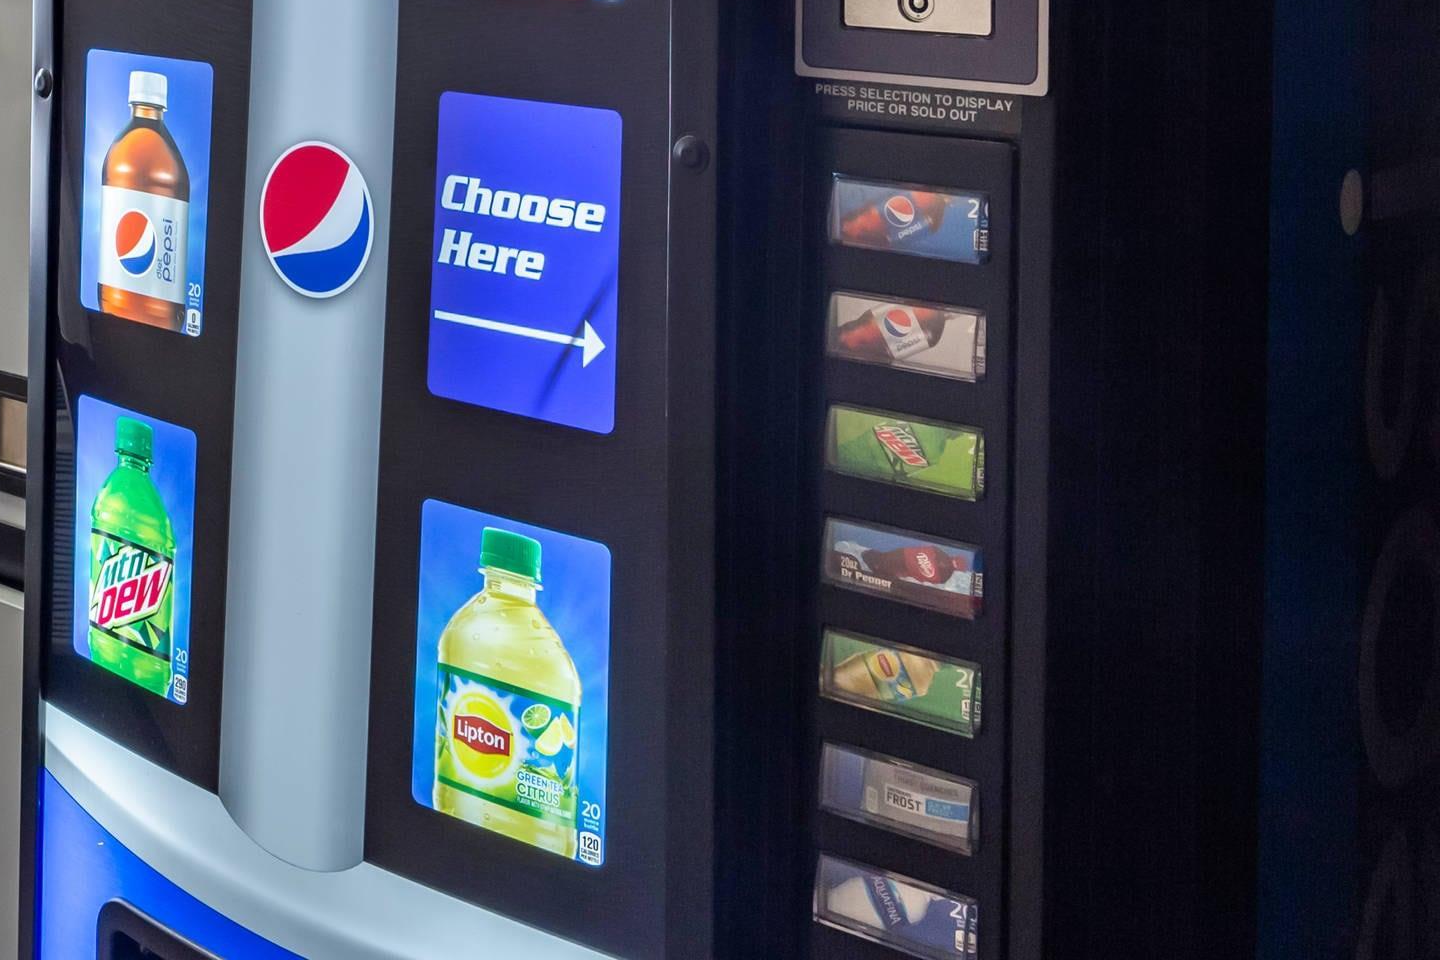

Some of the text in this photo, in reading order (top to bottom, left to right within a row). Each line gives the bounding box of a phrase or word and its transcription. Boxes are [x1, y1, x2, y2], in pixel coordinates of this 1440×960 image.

[815, 83, 1013, 112] PRESS SELECTION TO DISPLAY
[847, 99, 977, 122] PRICE OR SOLD OUT
[441, 174, 606, 233] Choose
[162, 218, 173, 283] pepsi
[437, 228, 545, 281] Here
[188, 282, 201, 298] 20
[841, 567, 892, 588] Dr Pepper
[175, 648, 188, 664] 20
[456, 717, 505, 751] Lipton
[517, 771, 564, 793] GREEN TEA
[517, 783, 559, 806] CITRUS
[887, 790, 922, 812] FROST
[581, 801, 600, 820] 20
[582, 835, 599, 852] 120
[870, 875, 901, 926] AQUAFINA
